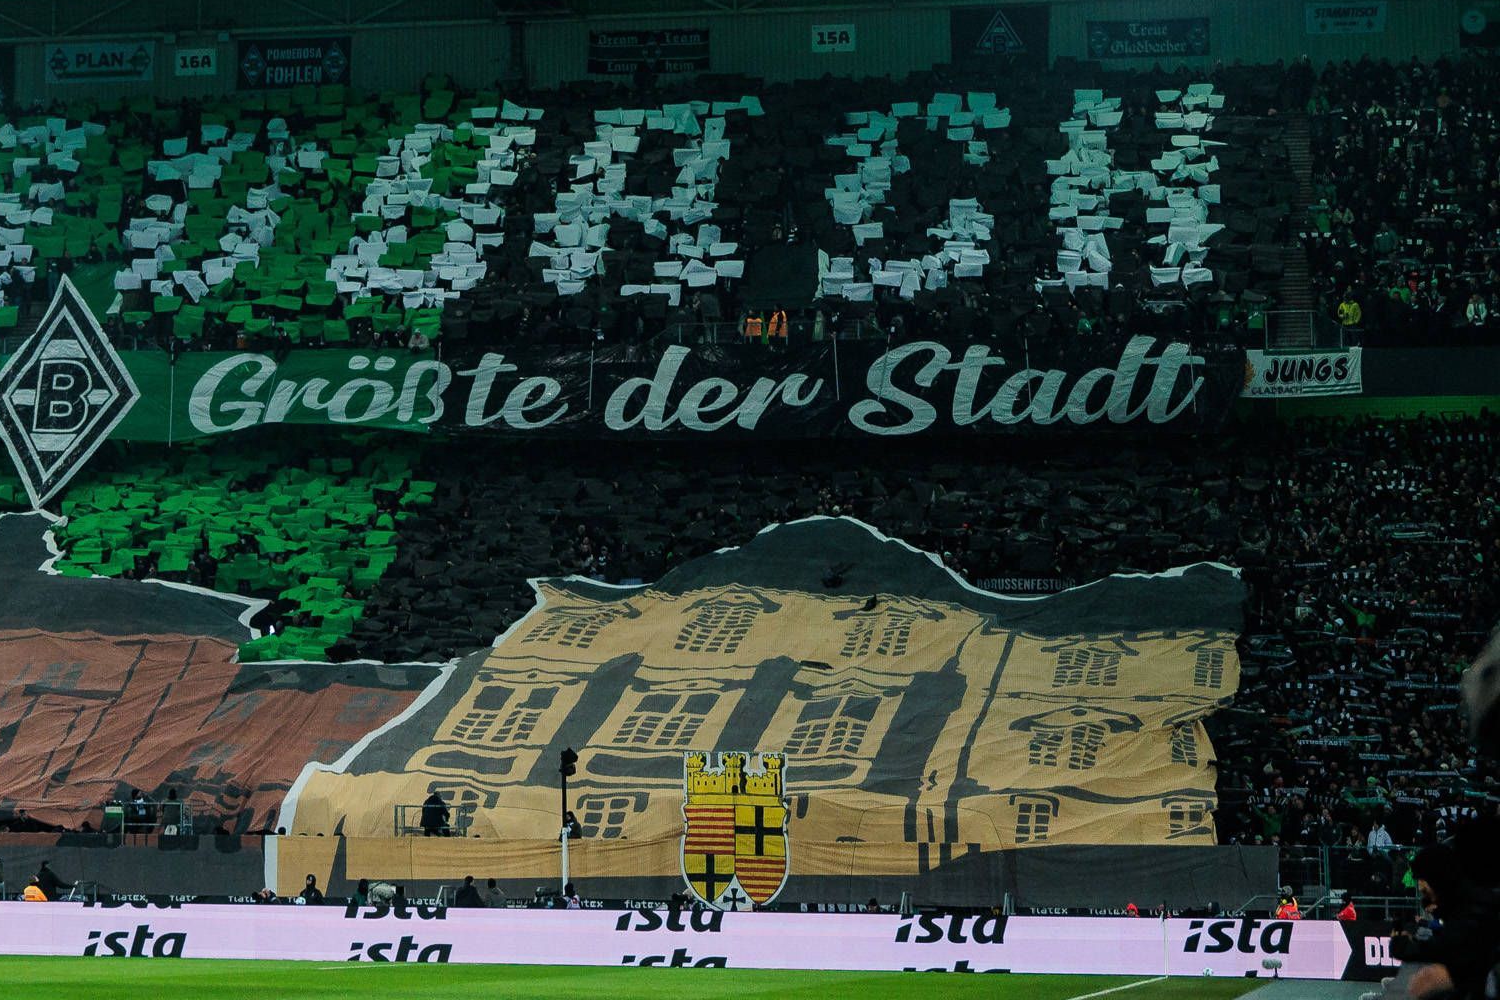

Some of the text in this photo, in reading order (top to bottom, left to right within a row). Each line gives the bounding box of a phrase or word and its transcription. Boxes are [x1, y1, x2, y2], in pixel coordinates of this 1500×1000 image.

[817, 31, 850, 45] 15A
[1128, 23, 1168, 36] Treue
[267, 48, 323, 61] PONDEROSA
[1110, 41, 1188, 54] Gladbacher
[75, 52, 125, 69] PLAN
[180, 55, 211, 69] 16A
[265, 65, 323, 85] FOHLEN
[1264, 356, 1348, 383] JUNGS
[189, 353, 569, 434] Größte
[605, 344, 827, 430] der
[848, 335, 1206, 435] Stadt
[895, 914, 1008, 944] ista
[1183, 919, 1294, 954] ista
[84, 925, 187, 958] ista
